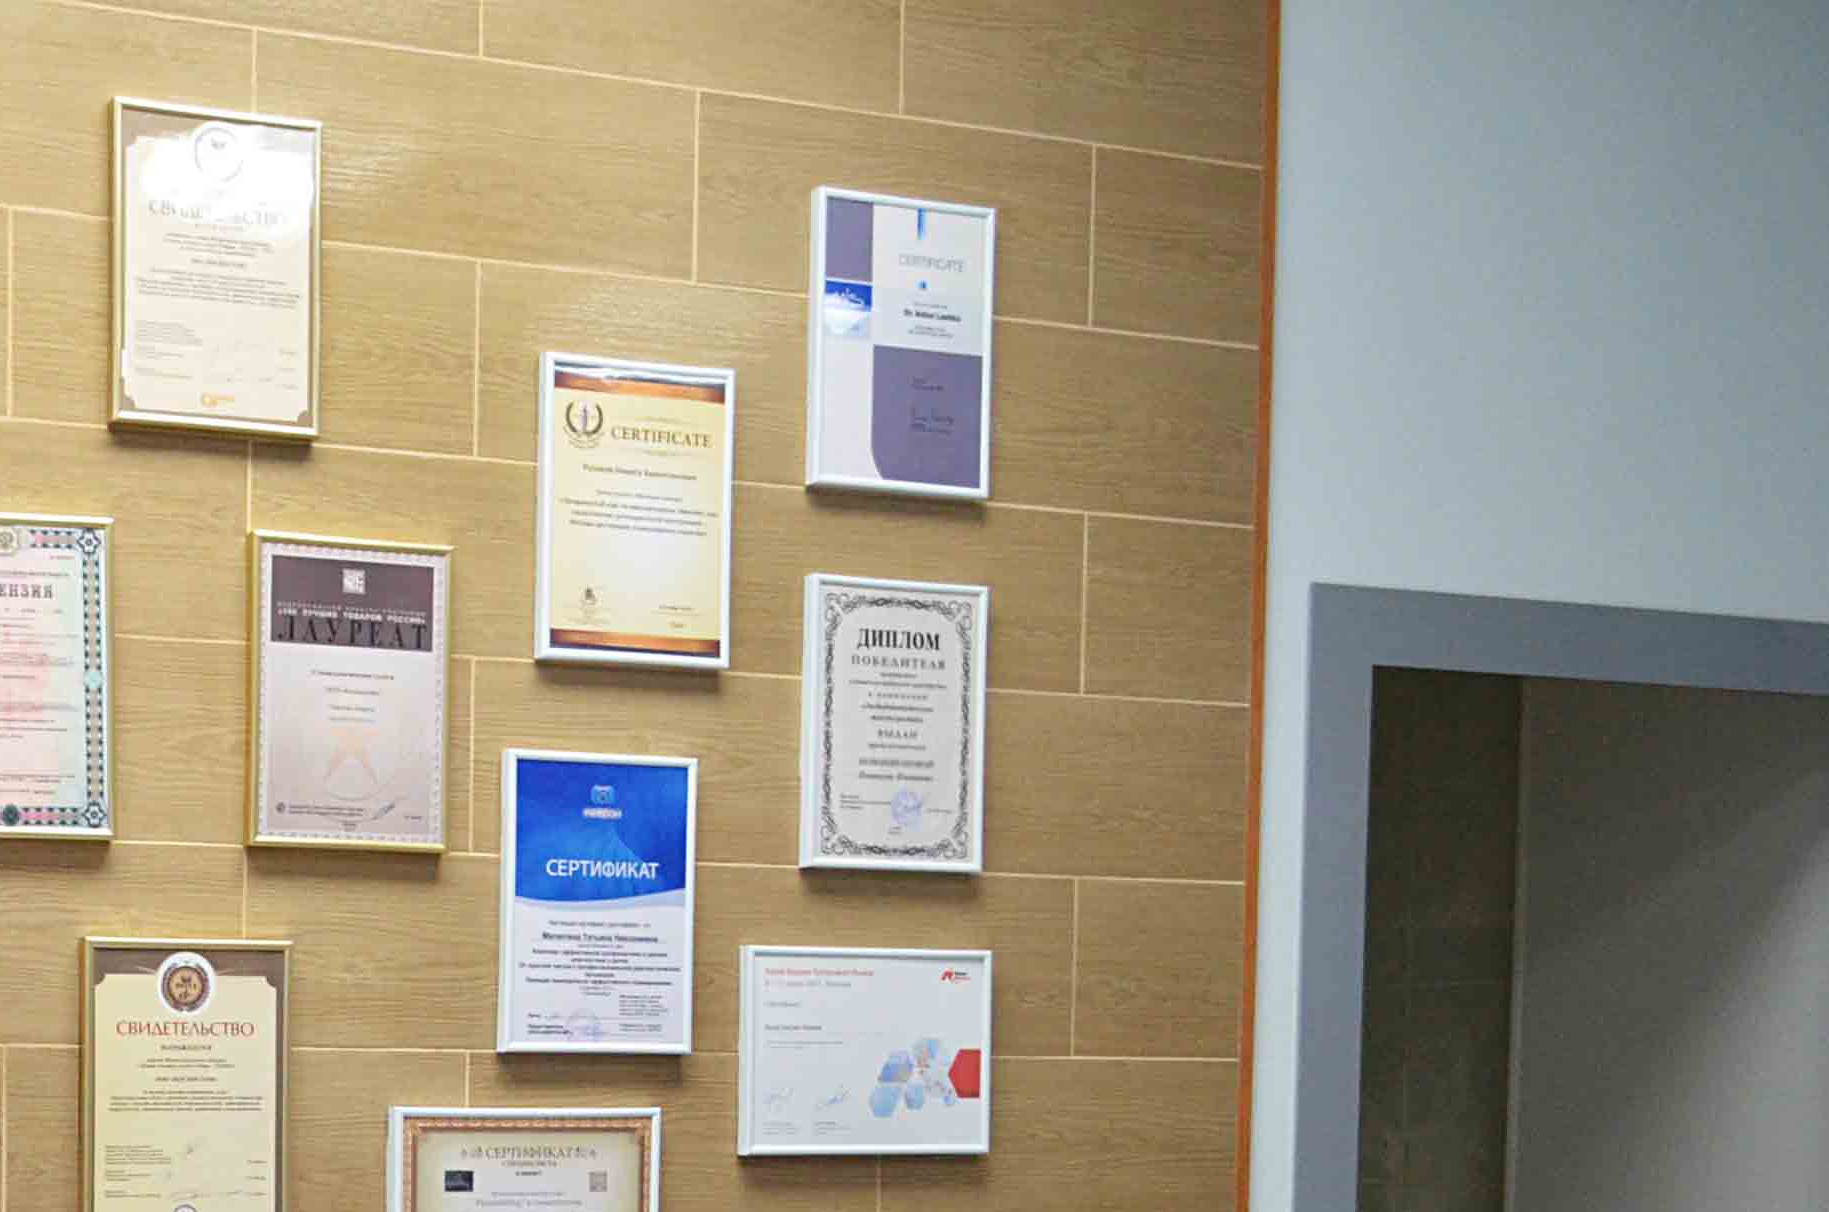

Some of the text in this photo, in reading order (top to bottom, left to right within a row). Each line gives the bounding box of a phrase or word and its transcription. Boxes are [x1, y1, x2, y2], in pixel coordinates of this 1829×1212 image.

[610, 426, 711, 448] CERTIFICATE
[277, 616, 428, 649] ЛАУРЕАТ
[857, 629, 940, 650] ДИПЛОМ
[851, 655, 946, 670] ПОБЕДИТЕЛЯ
[546, 859, 659, 880] СЕРТИФИКАТ
[116, 1020, 255, 1037] СВИДЕТЕЛЬСТВО
